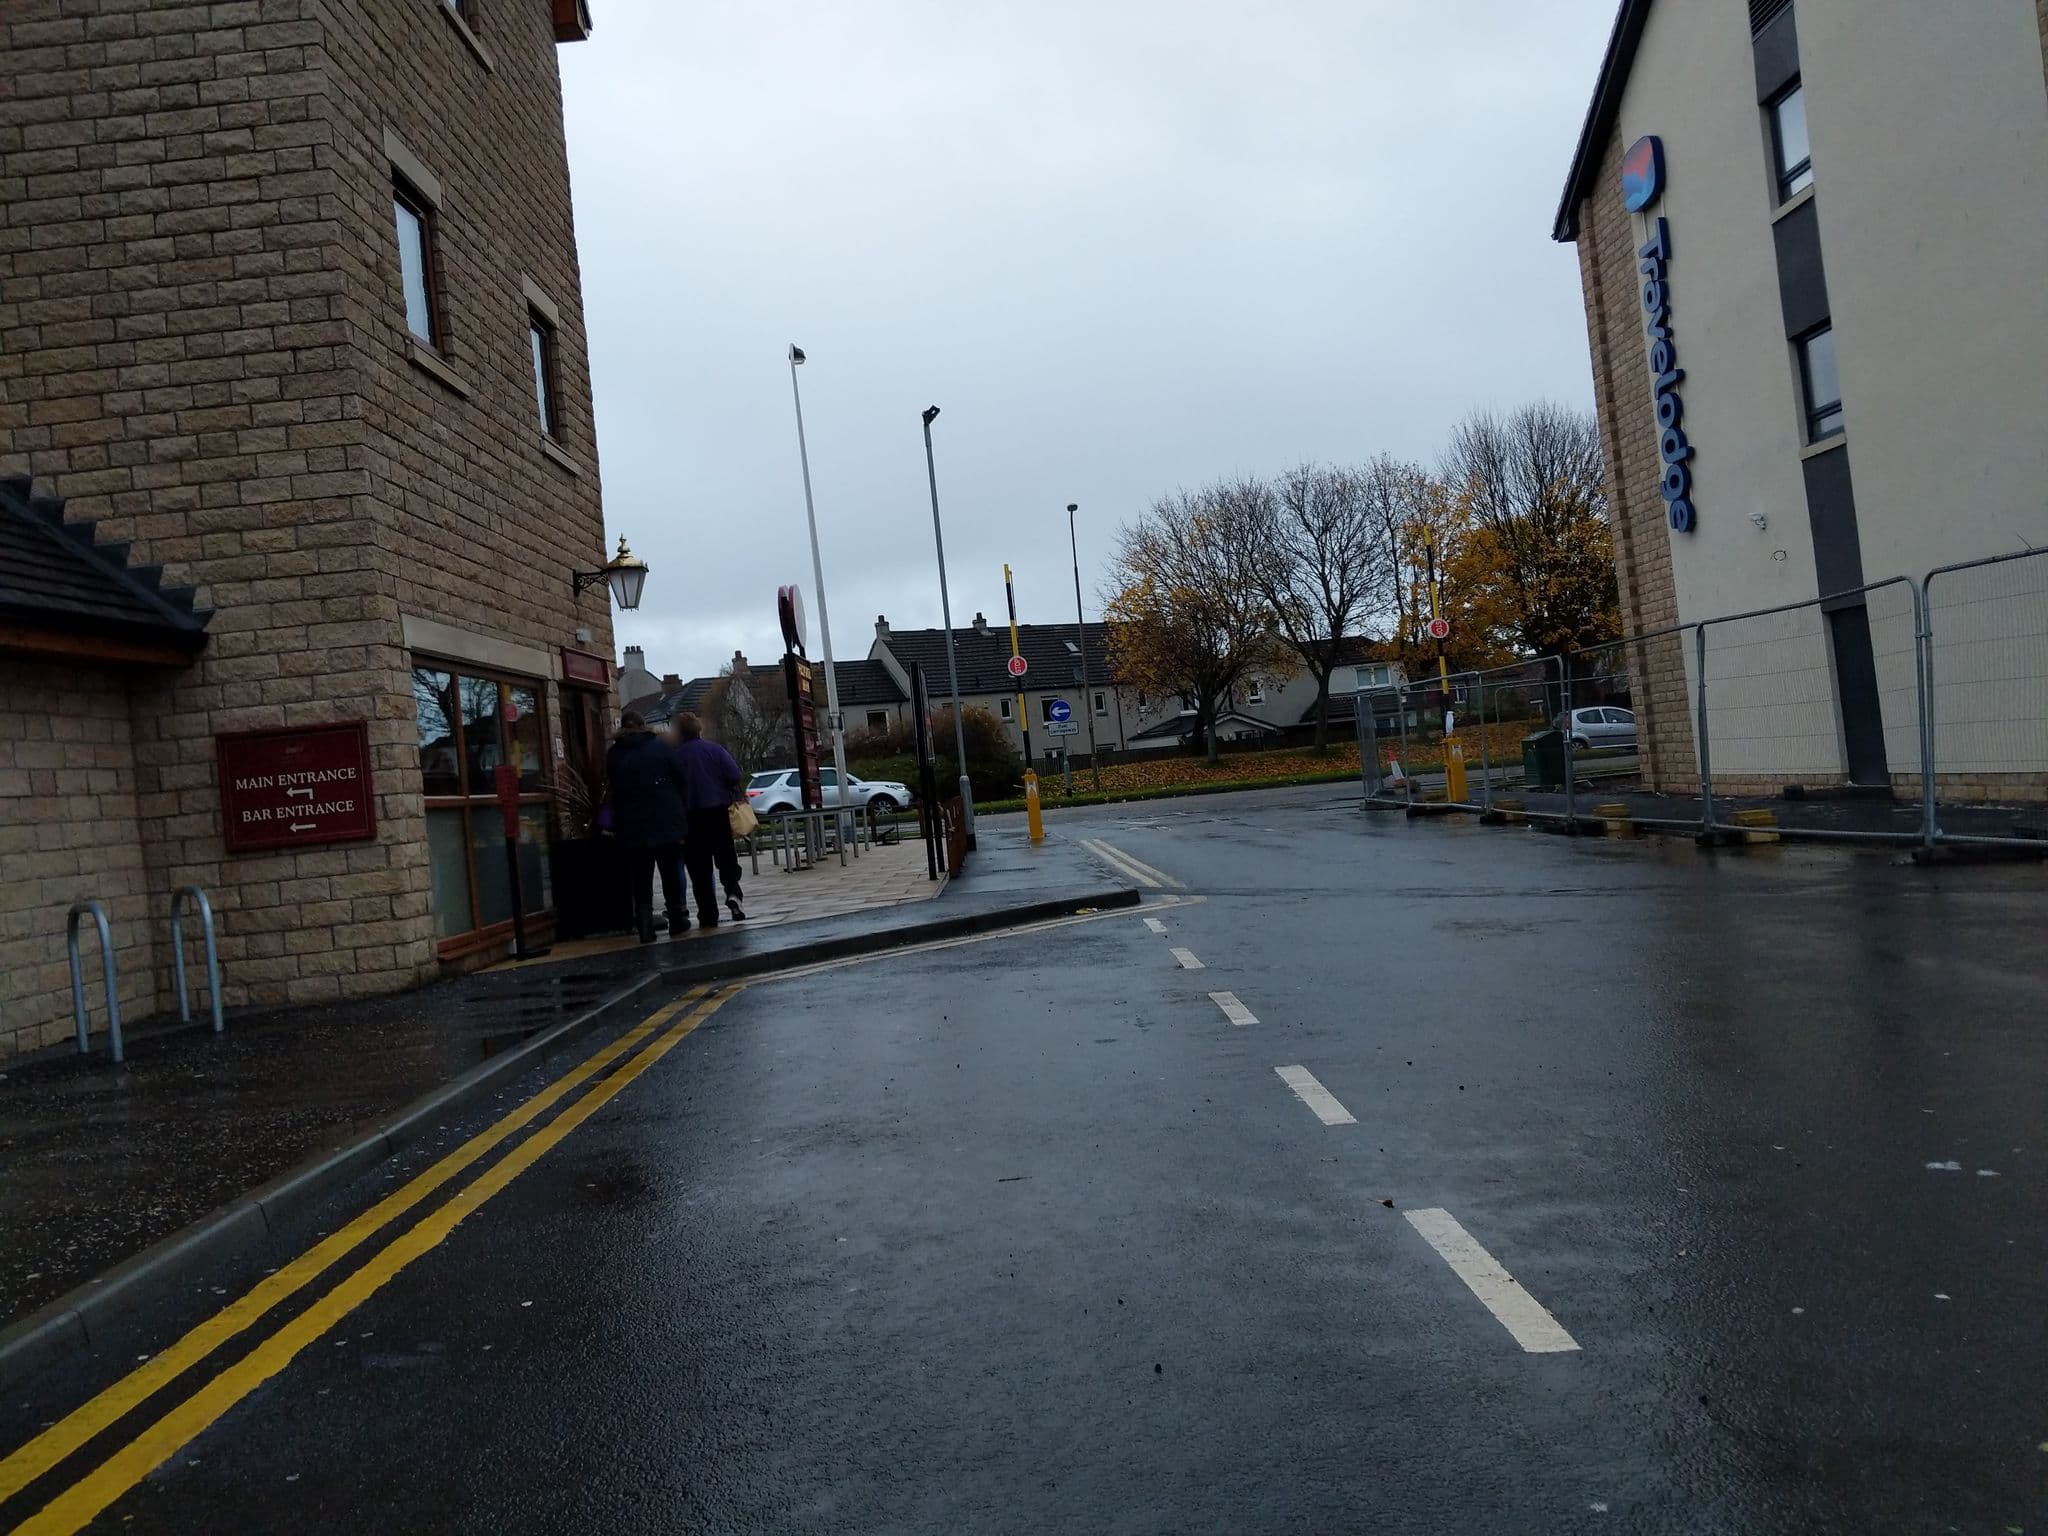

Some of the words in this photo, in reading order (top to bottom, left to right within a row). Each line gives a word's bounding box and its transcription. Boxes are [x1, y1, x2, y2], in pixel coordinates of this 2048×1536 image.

[1638, 216, 1697, 533] Travelodge
[235, 775, 274, 790] MAIN
[278, 767, 357, 786] ENTRANCE
[242, 809, 272, 822] BAR
[276, 800, 355, 819] ENTRANCE
